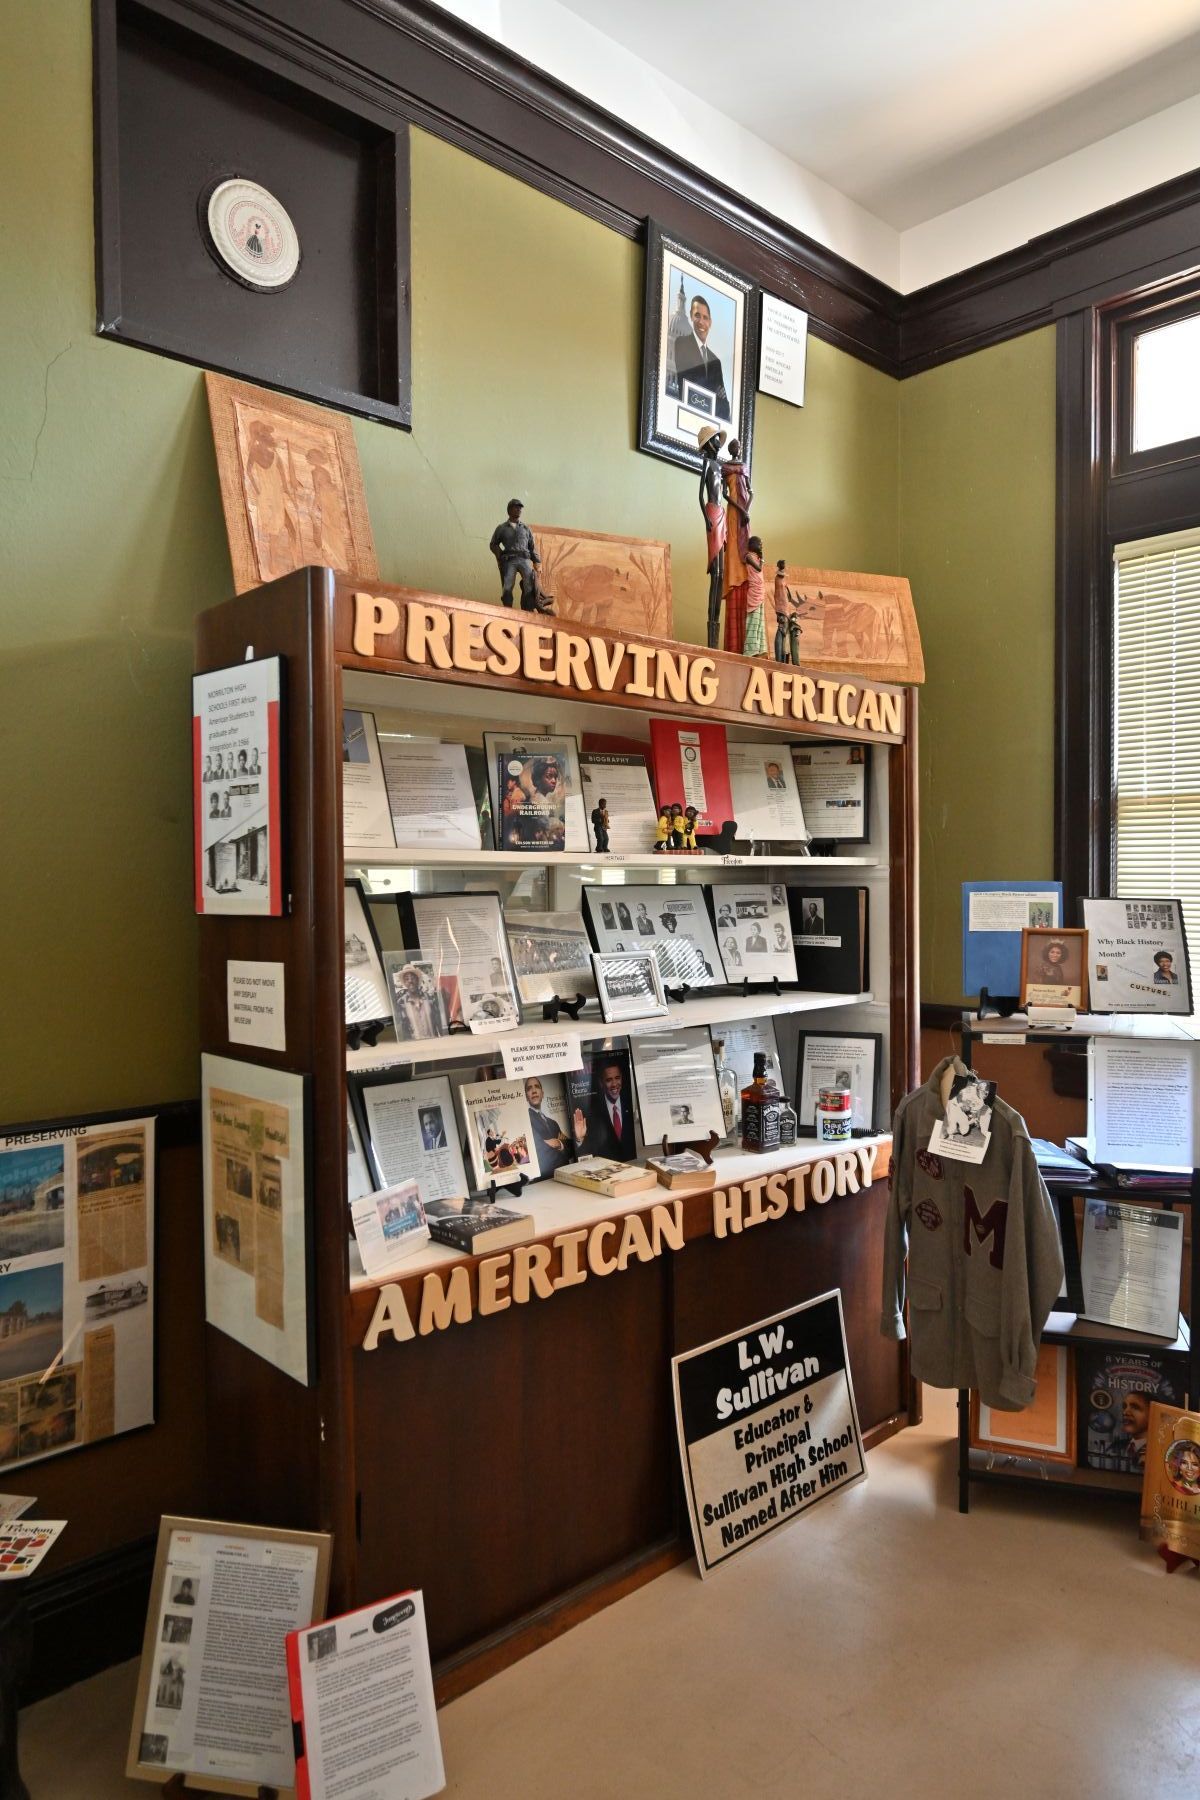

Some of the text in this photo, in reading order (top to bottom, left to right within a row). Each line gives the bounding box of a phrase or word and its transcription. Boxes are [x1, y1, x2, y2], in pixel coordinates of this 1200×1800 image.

[353, 592, 901, 734] PRESERVING AFRICAN
[512, 735, 552, 743] Sojourner Truth
[588, 755, 630, 763] BIOGRAPHY
[1097, 939, 1114, 947] Why
[1137, 939, 1164, 947] History
[511, 1045, 529, 1053] PLEASE
[465, 1097, 483, 1106] Martin
[483, 1095, 501, 1103] Luther
[501, 1093, 516, 1101] King,
[5, 1127, 87, 1146] PRESERVING
[362, 1145, 878, 1351] AMERICAN HISTORY
[963, 1185, 1009, 1270] M
[738, 1325, 793, 1370] L.W.
[1115, 1356, 1149, 1367] YEARS
[1151, 1360, 1161, 1368] OF
[716, 1357, 820, 1420] Sullivan
[1108, 1375, 1160, 1393] HISTORY
[733, 1394, 813, 1451] Educator &
[745, 1421, 811, 1473] Principal
[703, 1425, 854, 1526] Sullivan High School
[720, 1461, 848, 1547] Named After Him
